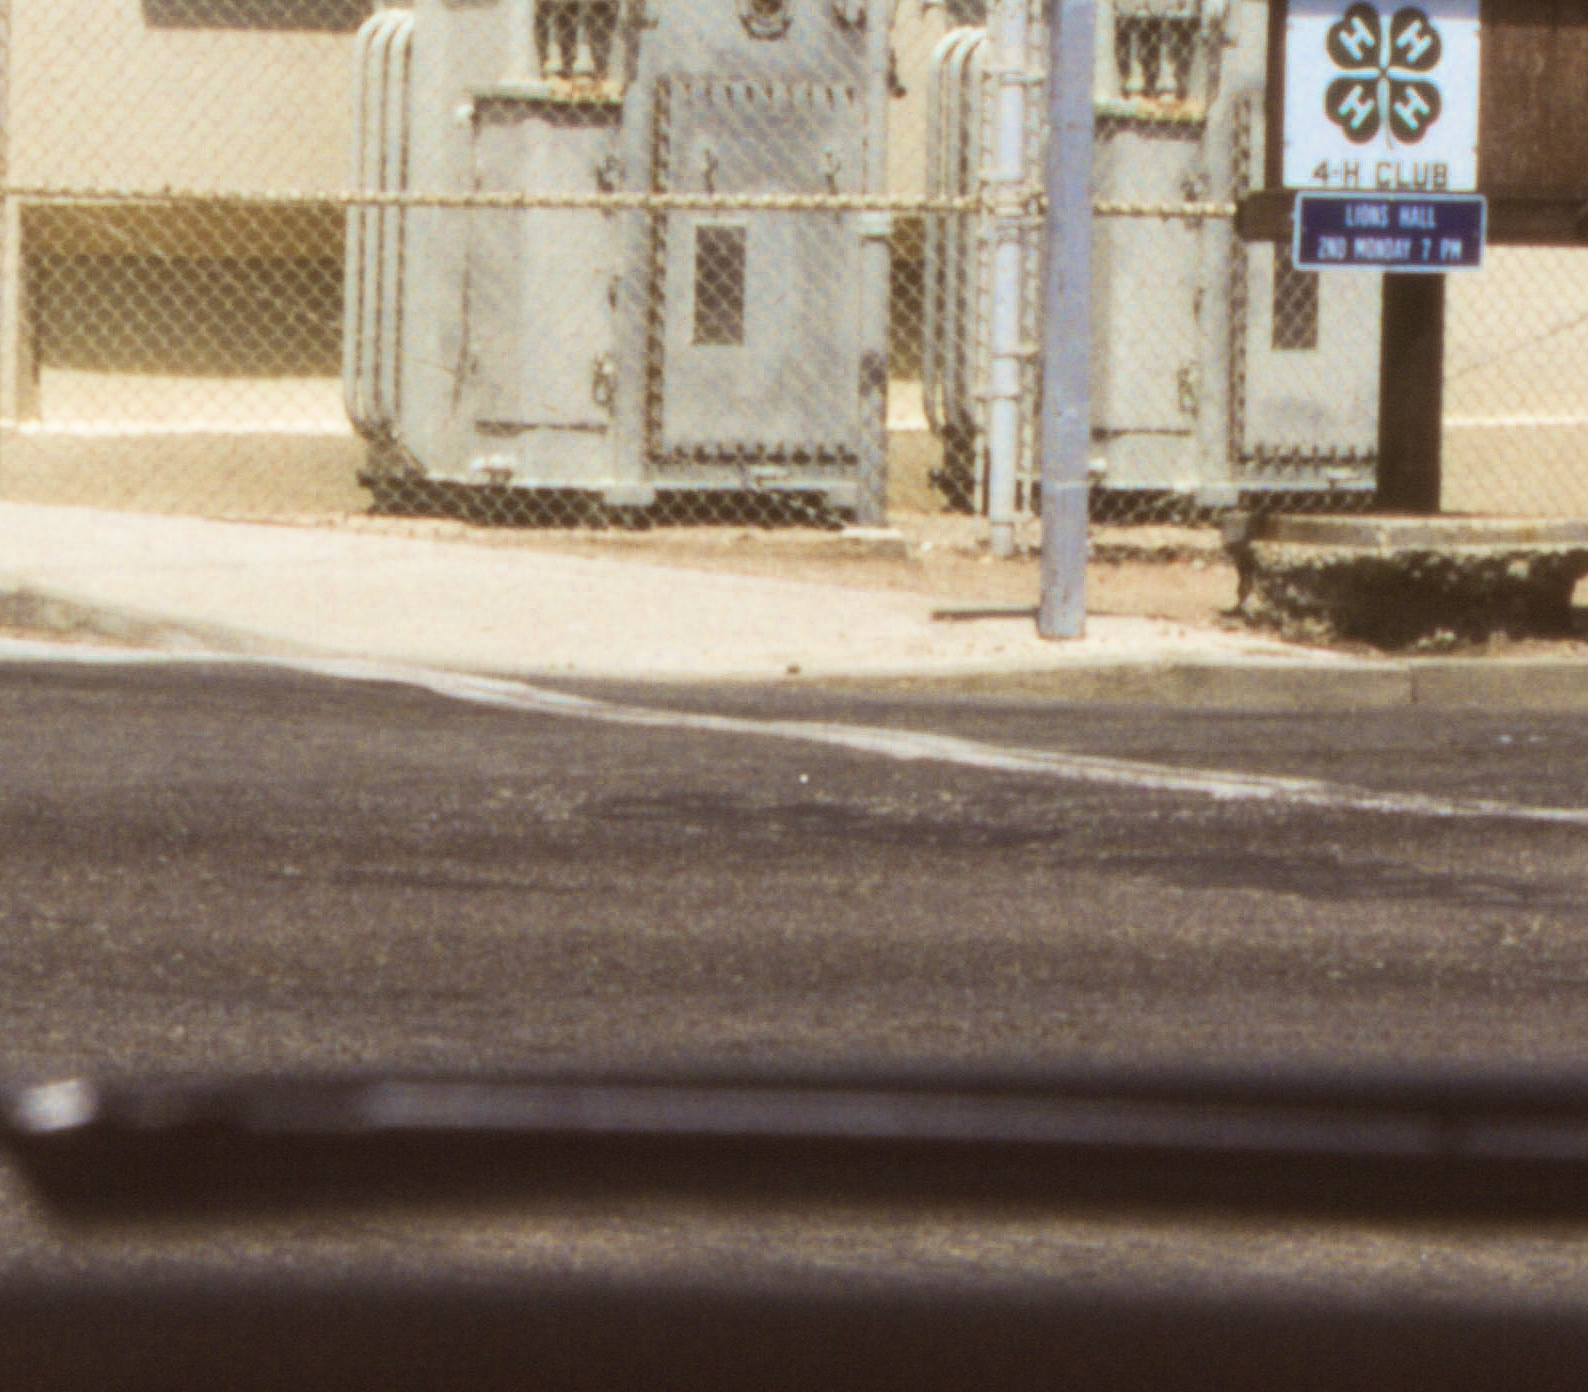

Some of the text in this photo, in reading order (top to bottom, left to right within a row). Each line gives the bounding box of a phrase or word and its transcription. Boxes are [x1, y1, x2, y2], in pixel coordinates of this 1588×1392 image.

[1339, 17, 1376, 61] H
[1396, 19, 1432, 63] H
[1338, 85, 1375, 129] H
[1394, 86, 1430, 130] H
[1312, 160, 1449, 191] 4-H CLUB
[1345, 204, 1436, 230] LIONS HALL
[1317, 235, 1462, 262] 2ND MONDAY 7 PM
